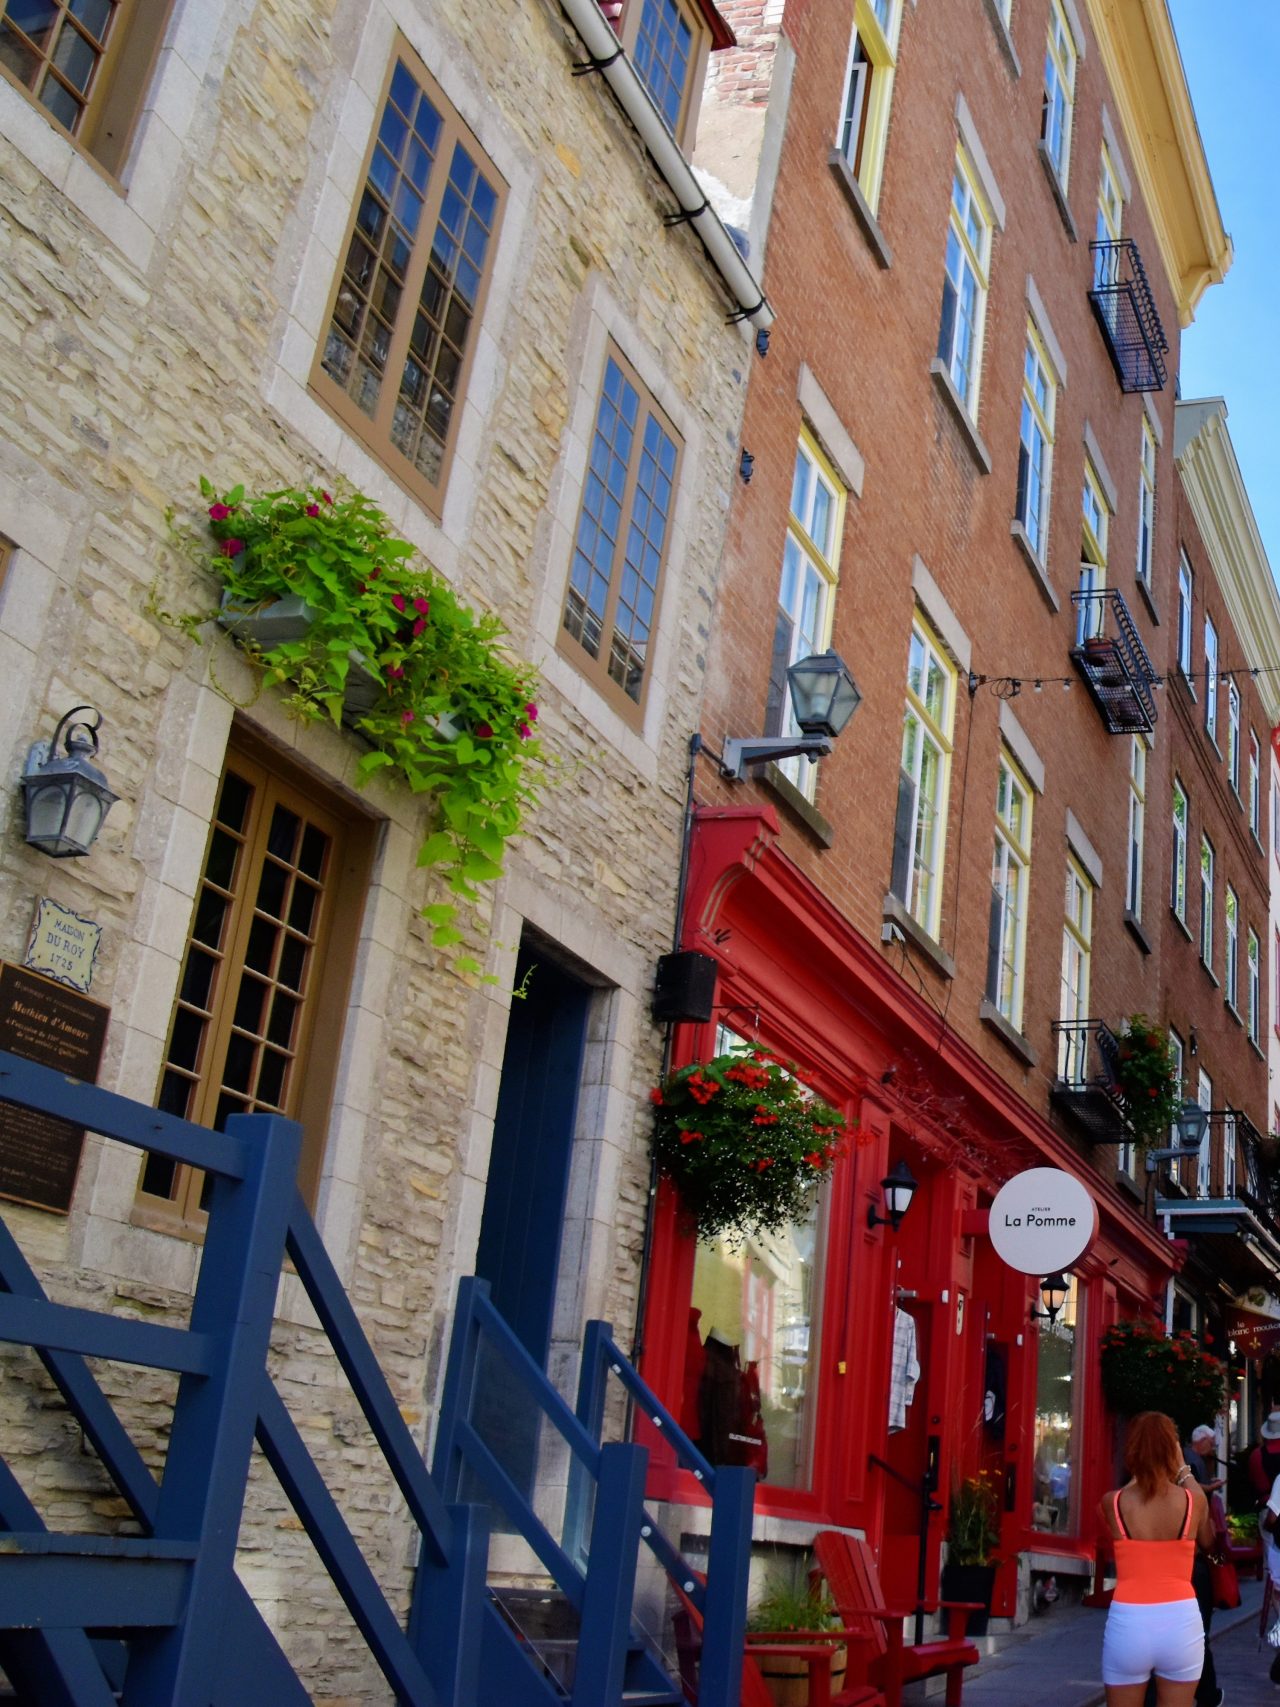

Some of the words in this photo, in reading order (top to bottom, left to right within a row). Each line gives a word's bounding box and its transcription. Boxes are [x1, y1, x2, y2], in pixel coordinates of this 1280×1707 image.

[54, 919, 86, 941] MAISON
[46, 931, 62, 947] DU
[63, 940, 86, 958] ROY
[50, 953, 73, 971] 1725
[1005, 1214, 1021, 1227] La
[1026, 1214, 1076, 1227] Pomme
